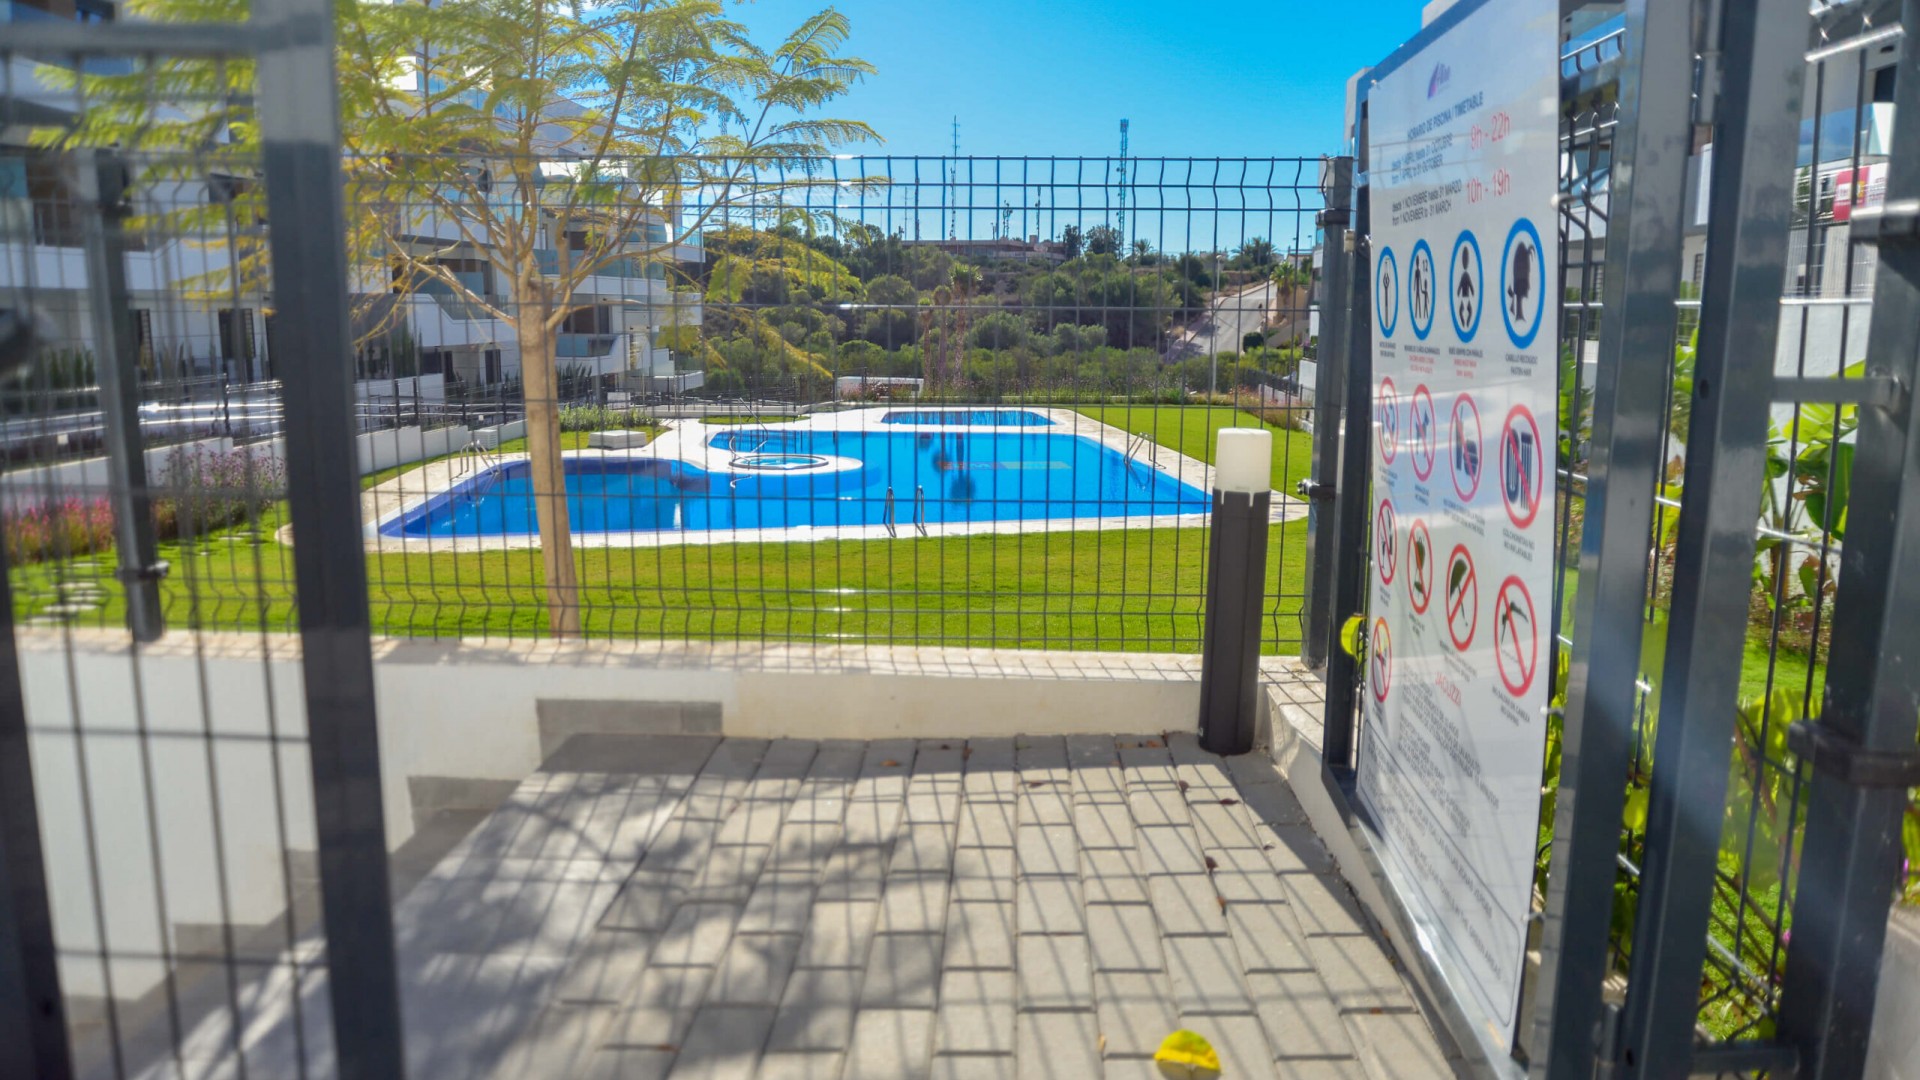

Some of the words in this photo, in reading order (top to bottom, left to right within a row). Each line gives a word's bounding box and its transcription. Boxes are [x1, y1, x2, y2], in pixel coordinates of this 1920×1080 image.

[1433, 109, 1451, 128] PISCINA
[1454, 91, 1483, 118] TIMETABLE
[1471, 124, 1483, 151] 9h
[1491, 110, 1511, 142] 22h
[1445, 178, 1462, 196] MARZO
[1466, 176, 1483, 205] 10h
[1492, 168, 1511, 197] 19h
[1435, 199, 1452, 215] MARCH
[1423, 258, 1428, 273] 12
